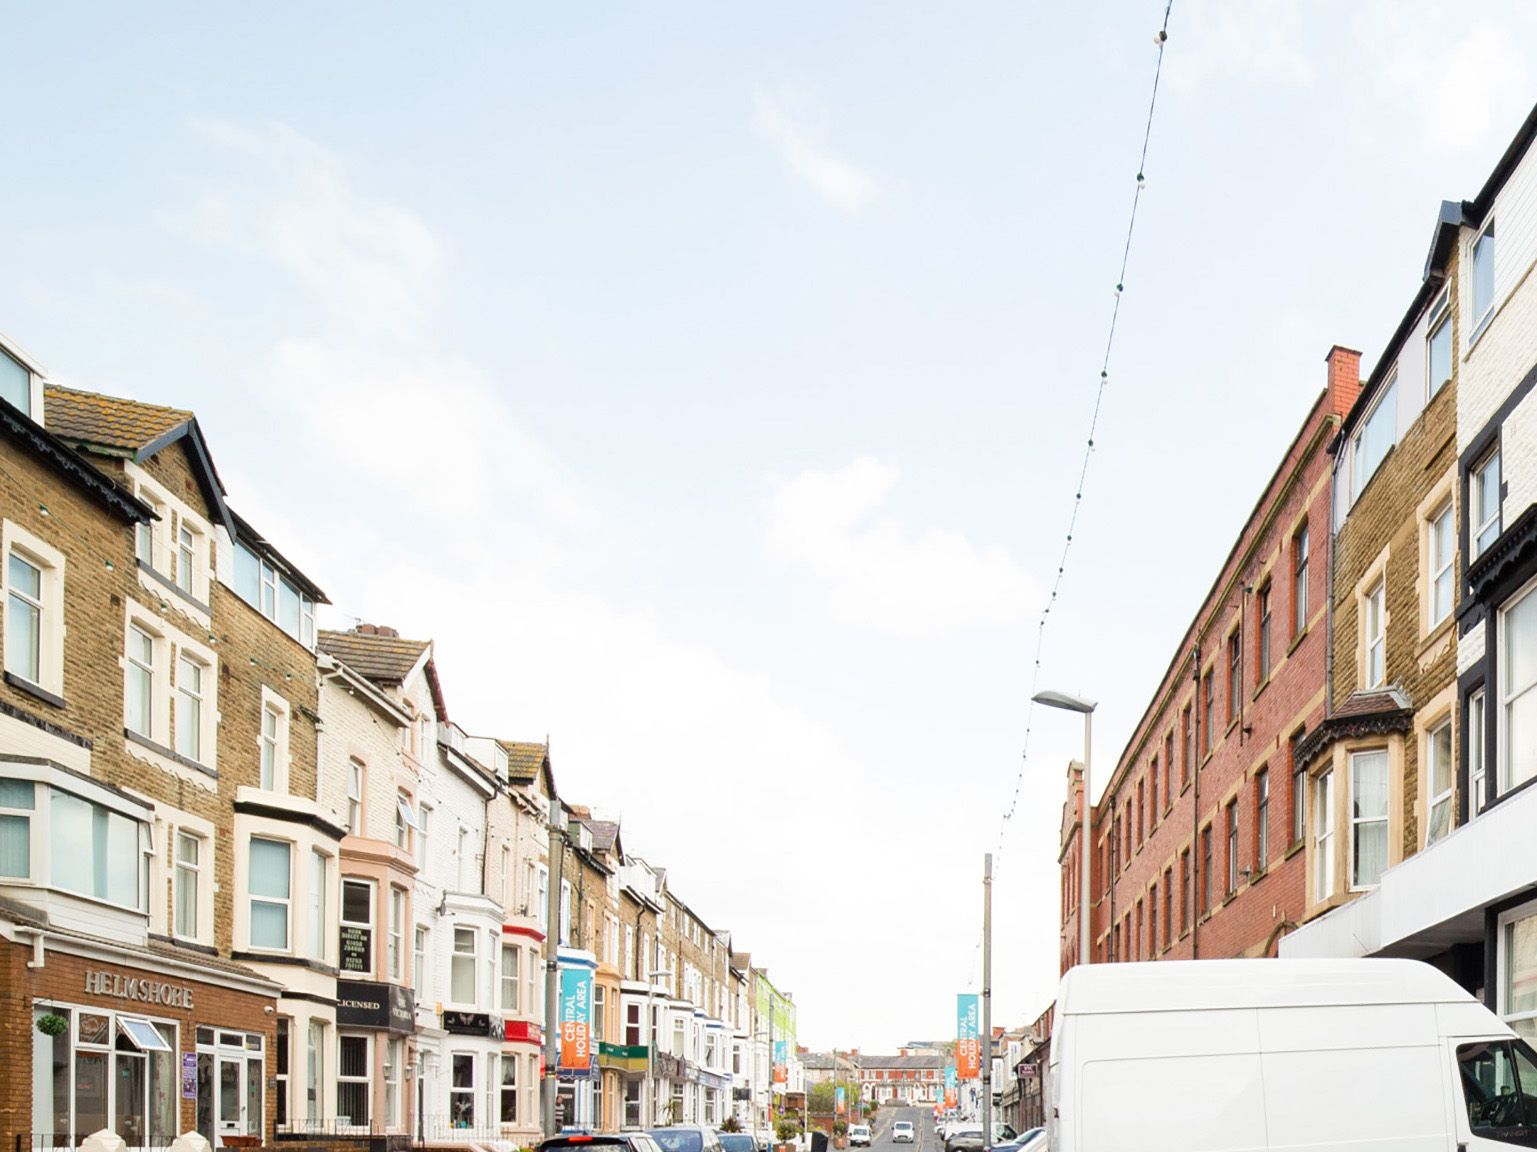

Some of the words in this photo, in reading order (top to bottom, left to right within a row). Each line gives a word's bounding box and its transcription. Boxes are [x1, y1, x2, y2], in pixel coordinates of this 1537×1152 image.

[84, 969, 194, 1009] HELMSHORE
[576, 980, 587, 1009] AREA
[565, 994, 576, 1042] CENTRAL
[576, 1011, 587, 1058] HOLIDAY
[960, 1017, 968, 1056] CENTRAL
[968, 1029, 977, 1070] HOLIDAY
